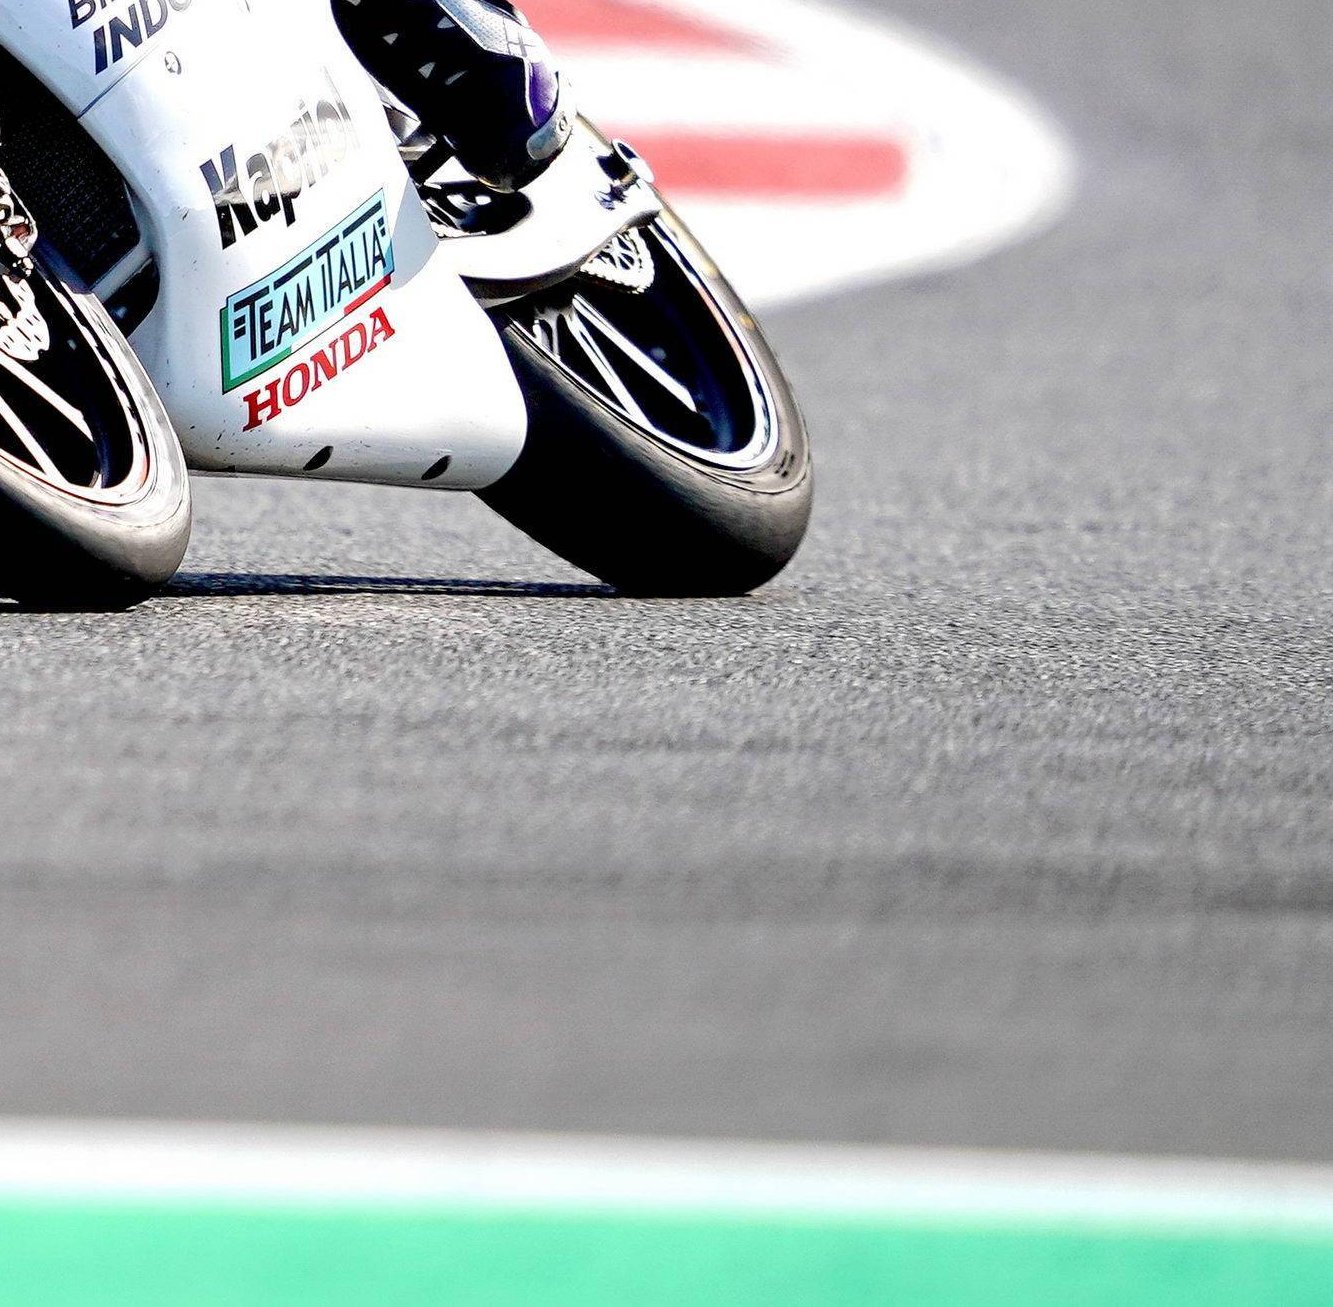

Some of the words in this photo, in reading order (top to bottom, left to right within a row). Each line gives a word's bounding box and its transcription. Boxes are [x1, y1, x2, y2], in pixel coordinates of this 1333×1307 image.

[234, 256, 315, 362] TEAM
[316, 206, 388, 313] ITALIA
[243, 306, 396, 432] HONDA
